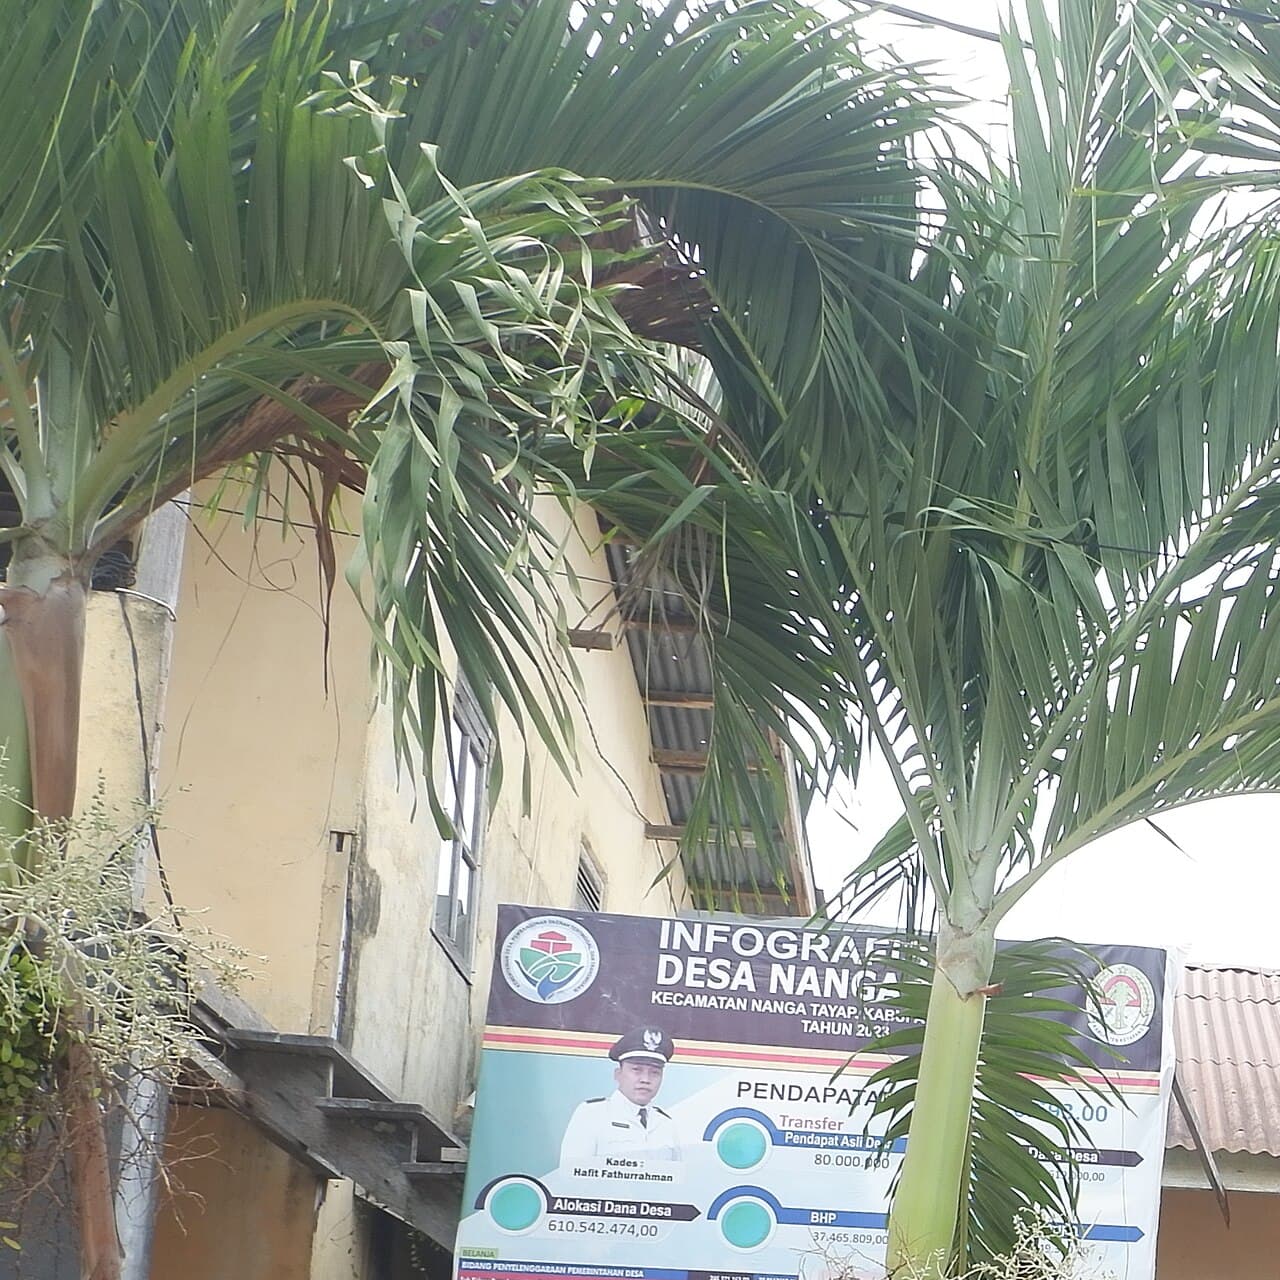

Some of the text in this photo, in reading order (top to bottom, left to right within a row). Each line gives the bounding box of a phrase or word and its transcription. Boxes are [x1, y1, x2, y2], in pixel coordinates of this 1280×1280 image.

[656, 954, 901, 1002] DESA NANGA
[651, 991, 748, 1010] KECAMATAN
[751, 999, 806, 1016] NANGA
[801, 1020, 852, 1036] TAHUN
[737, 1081, 885, 1106] PENDAPATA
[779, 1115, 844, 1131] Transfer
[785, 1132, 838, 1148] Pendapat
[842, 1135, 863, 1148] Asli
[606, 1158, 639, 1168] Kades
[574, 1168, 673, 1181] Hafit Fathurrahman
[553, 1198, 672, 1217] Alokasi Dana Desa
[810, 1212, 836, 1224] BHP
[548, 1220, 658, 1237] 610.542.474,00
[462, 1249, 495, 1258] BELANJA
